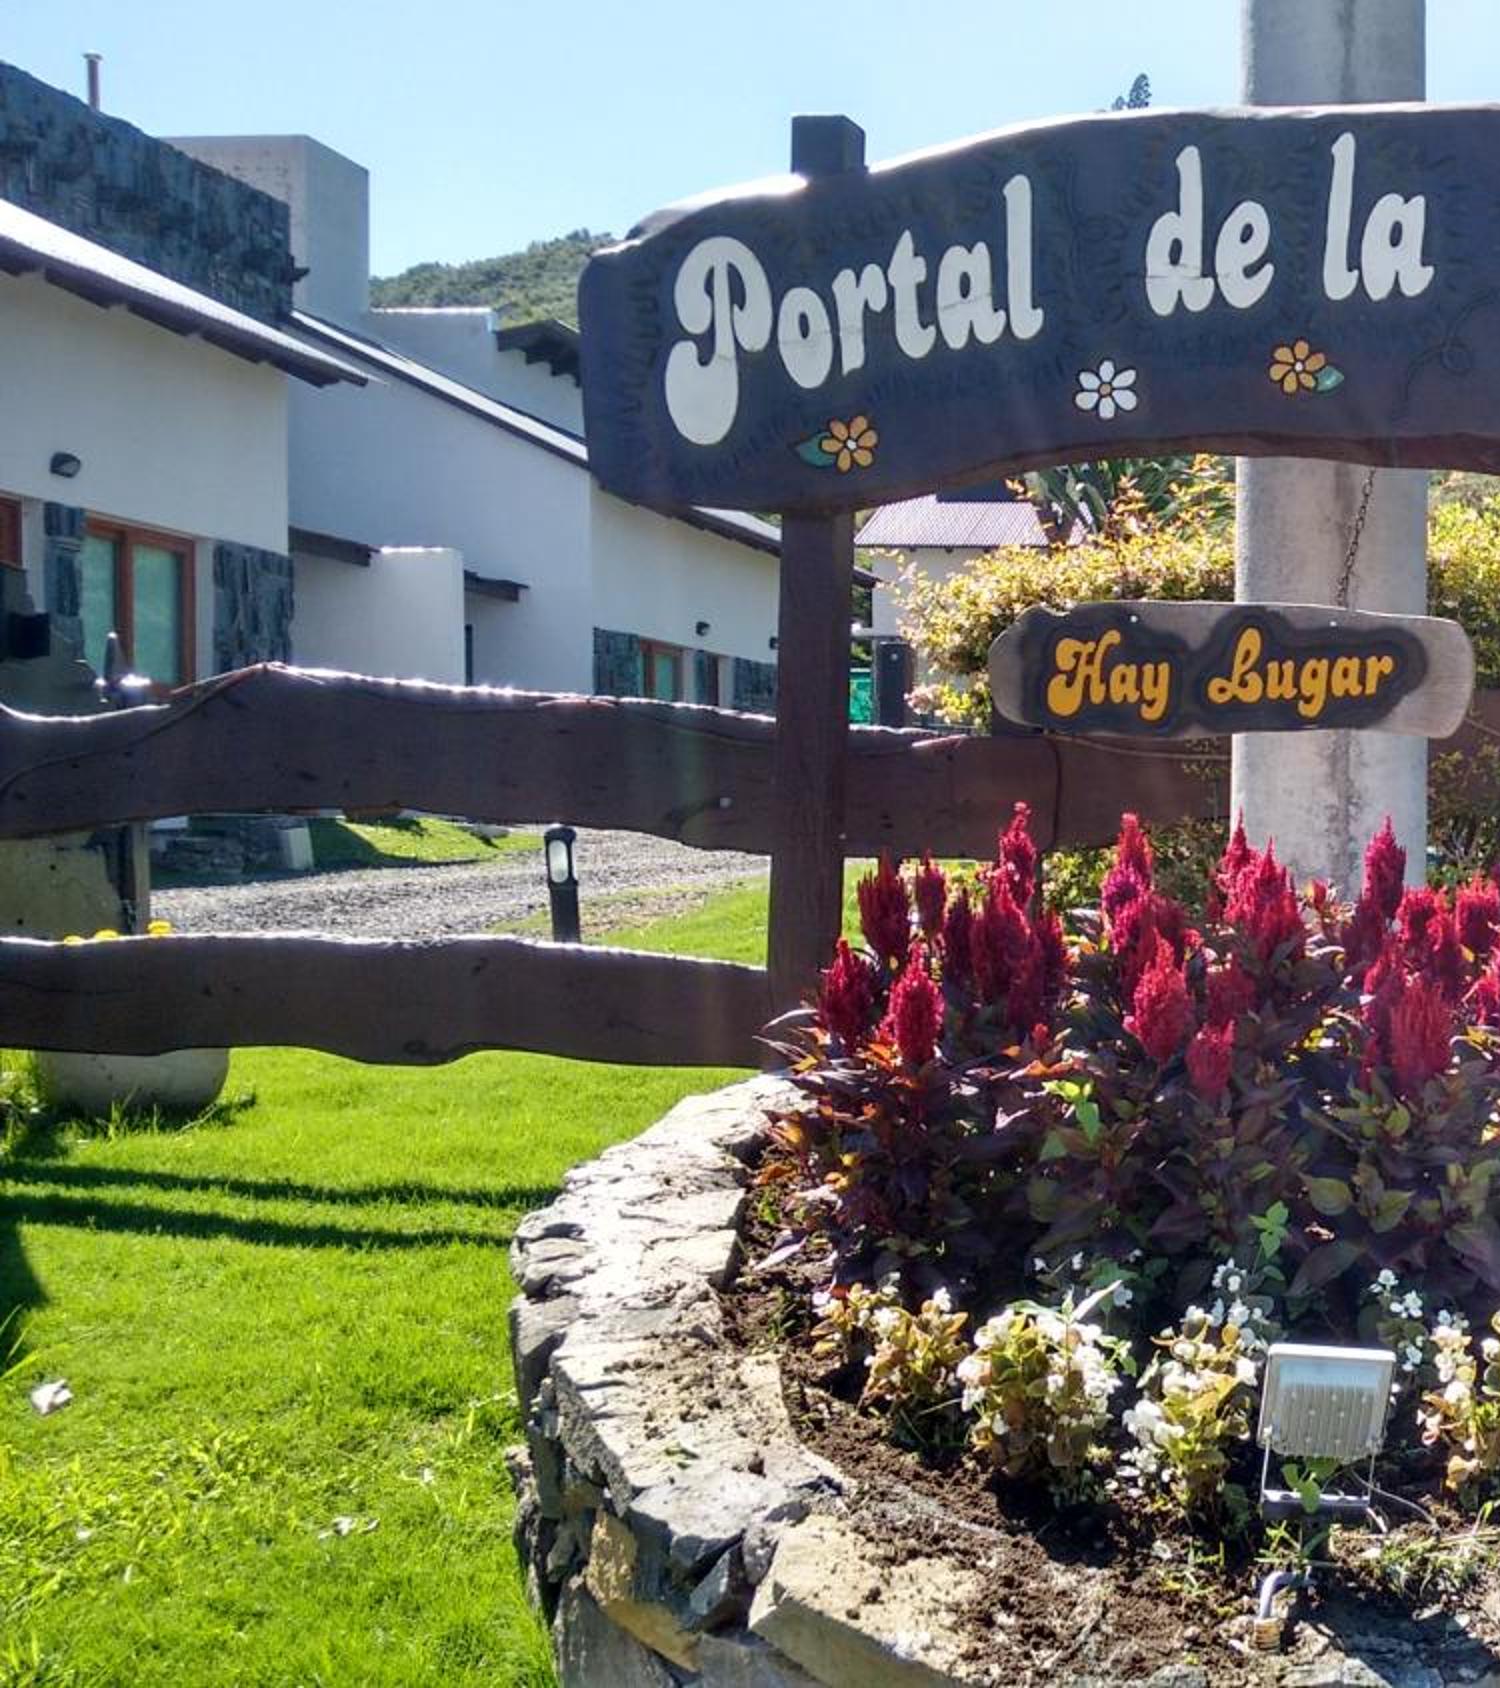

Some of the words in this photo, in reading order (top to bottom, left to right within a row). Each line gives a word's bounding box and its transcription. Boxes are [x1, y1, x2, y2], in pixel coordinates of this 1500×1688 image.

[665, 174, 1044, 445] Portal
[1145, 145, 1275, 316] de
[1323, 132, 1435, 301] la
[1047, 629, 1171, 721] Hay
[1207, 627, 1395, 719] Lugar
